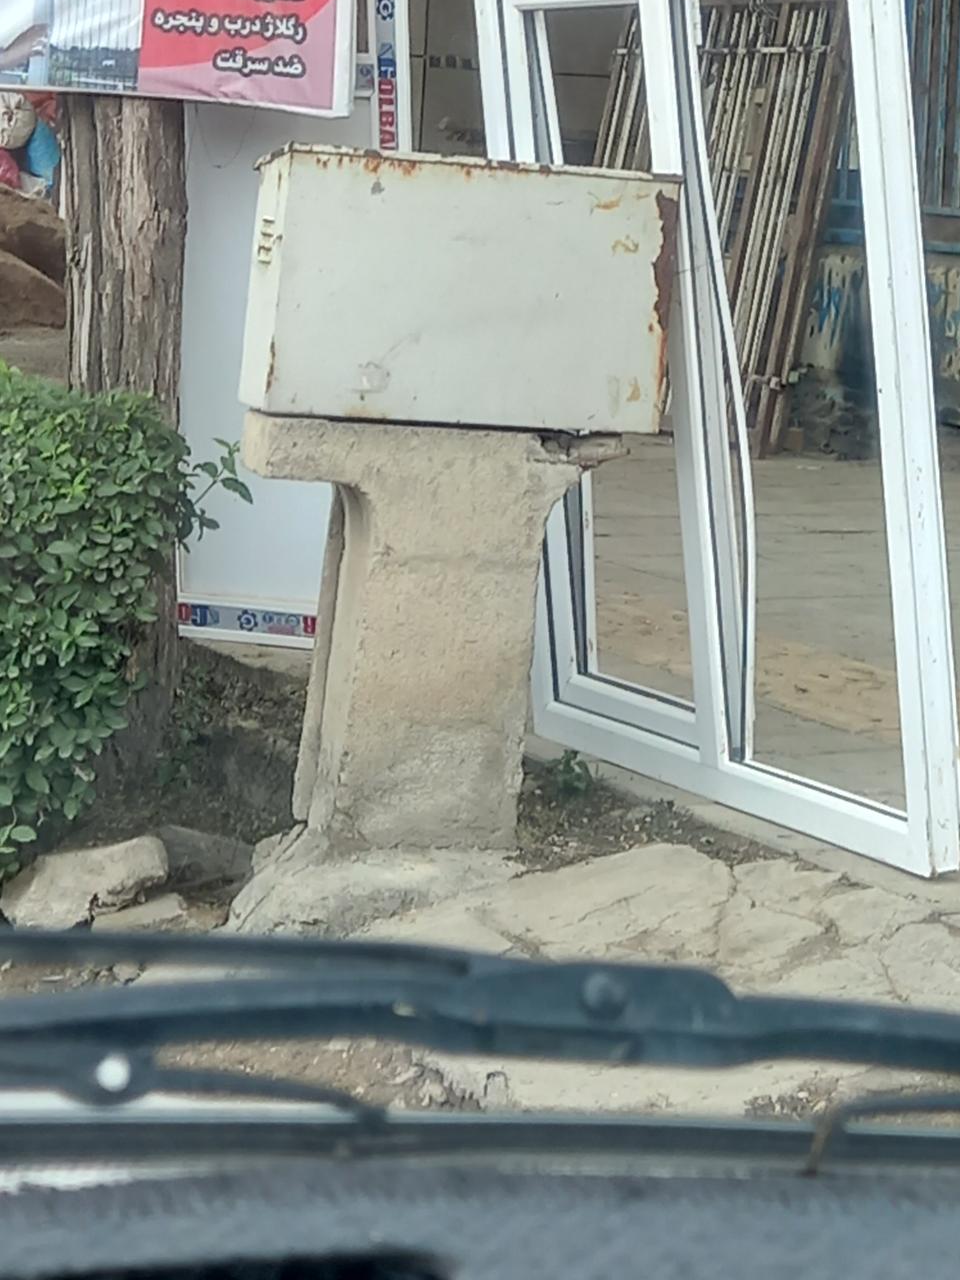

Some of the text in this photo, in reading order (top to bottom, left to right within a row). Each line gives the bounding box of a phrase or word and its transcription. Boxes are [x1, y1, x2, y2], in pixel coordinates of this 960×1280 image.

[153, 9, 305, 42] رگلاژ درب و پنجره
[215, 48, 304, 77] ضد سرقت
